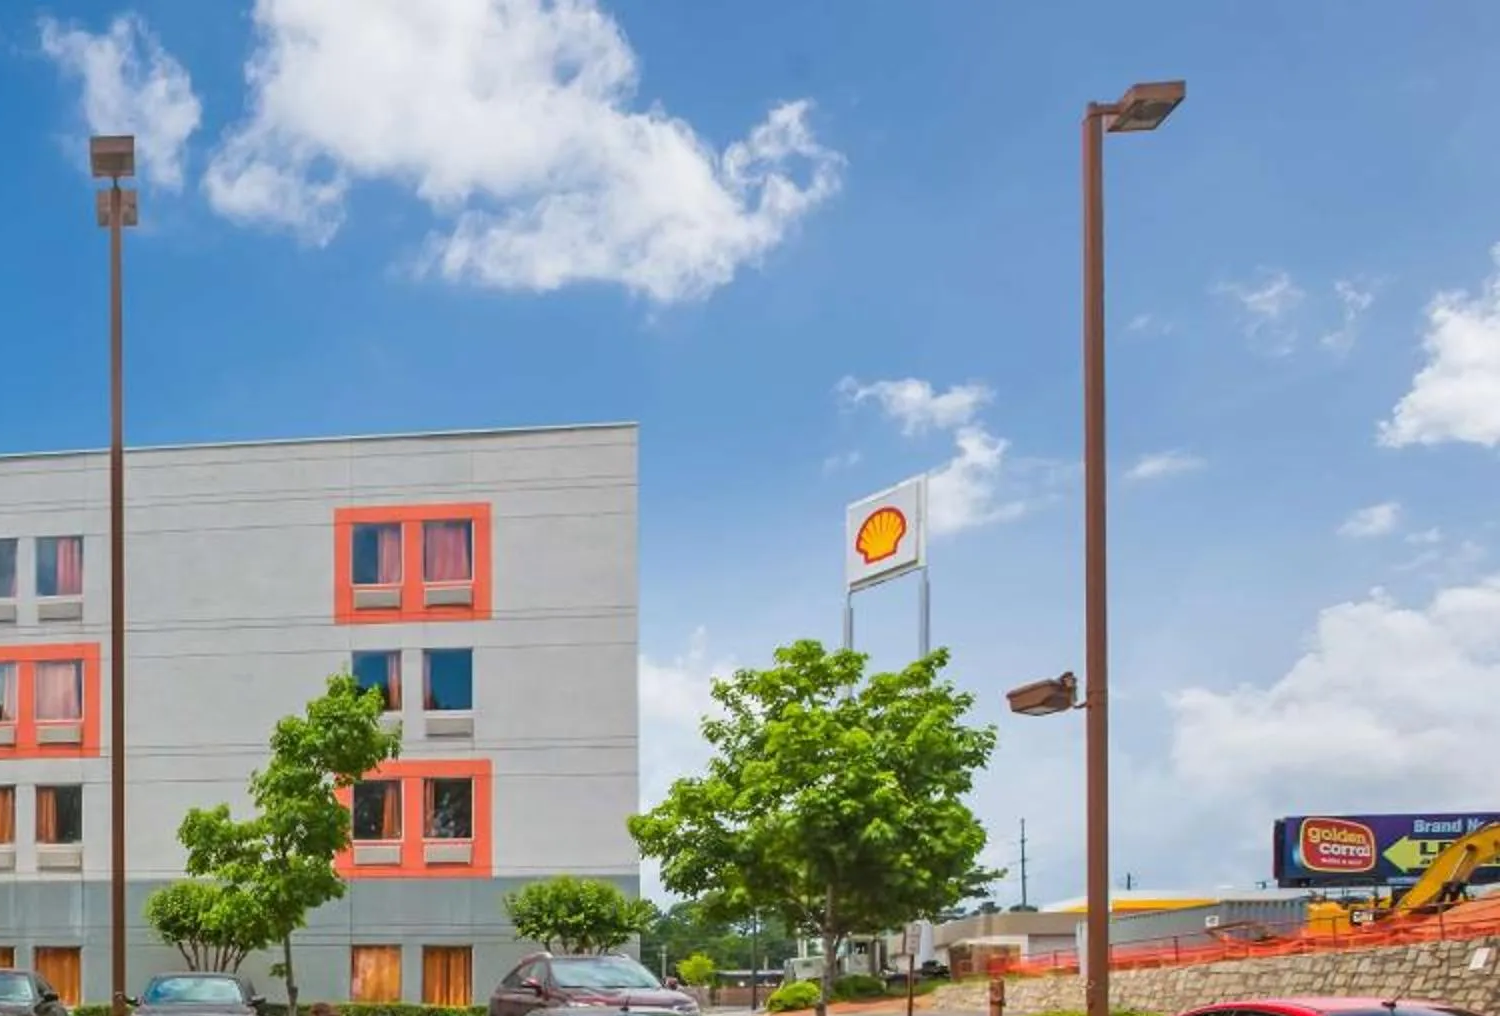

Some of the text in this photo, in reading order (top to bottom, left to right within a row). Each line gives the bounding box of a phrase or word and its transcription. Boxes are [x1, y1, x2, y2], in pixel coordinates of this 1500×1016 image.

[1413, 819, 1462, 833] Brand
[1307, 826, 1367, 845] golden
[1319, 842, 1371, 857] corral
